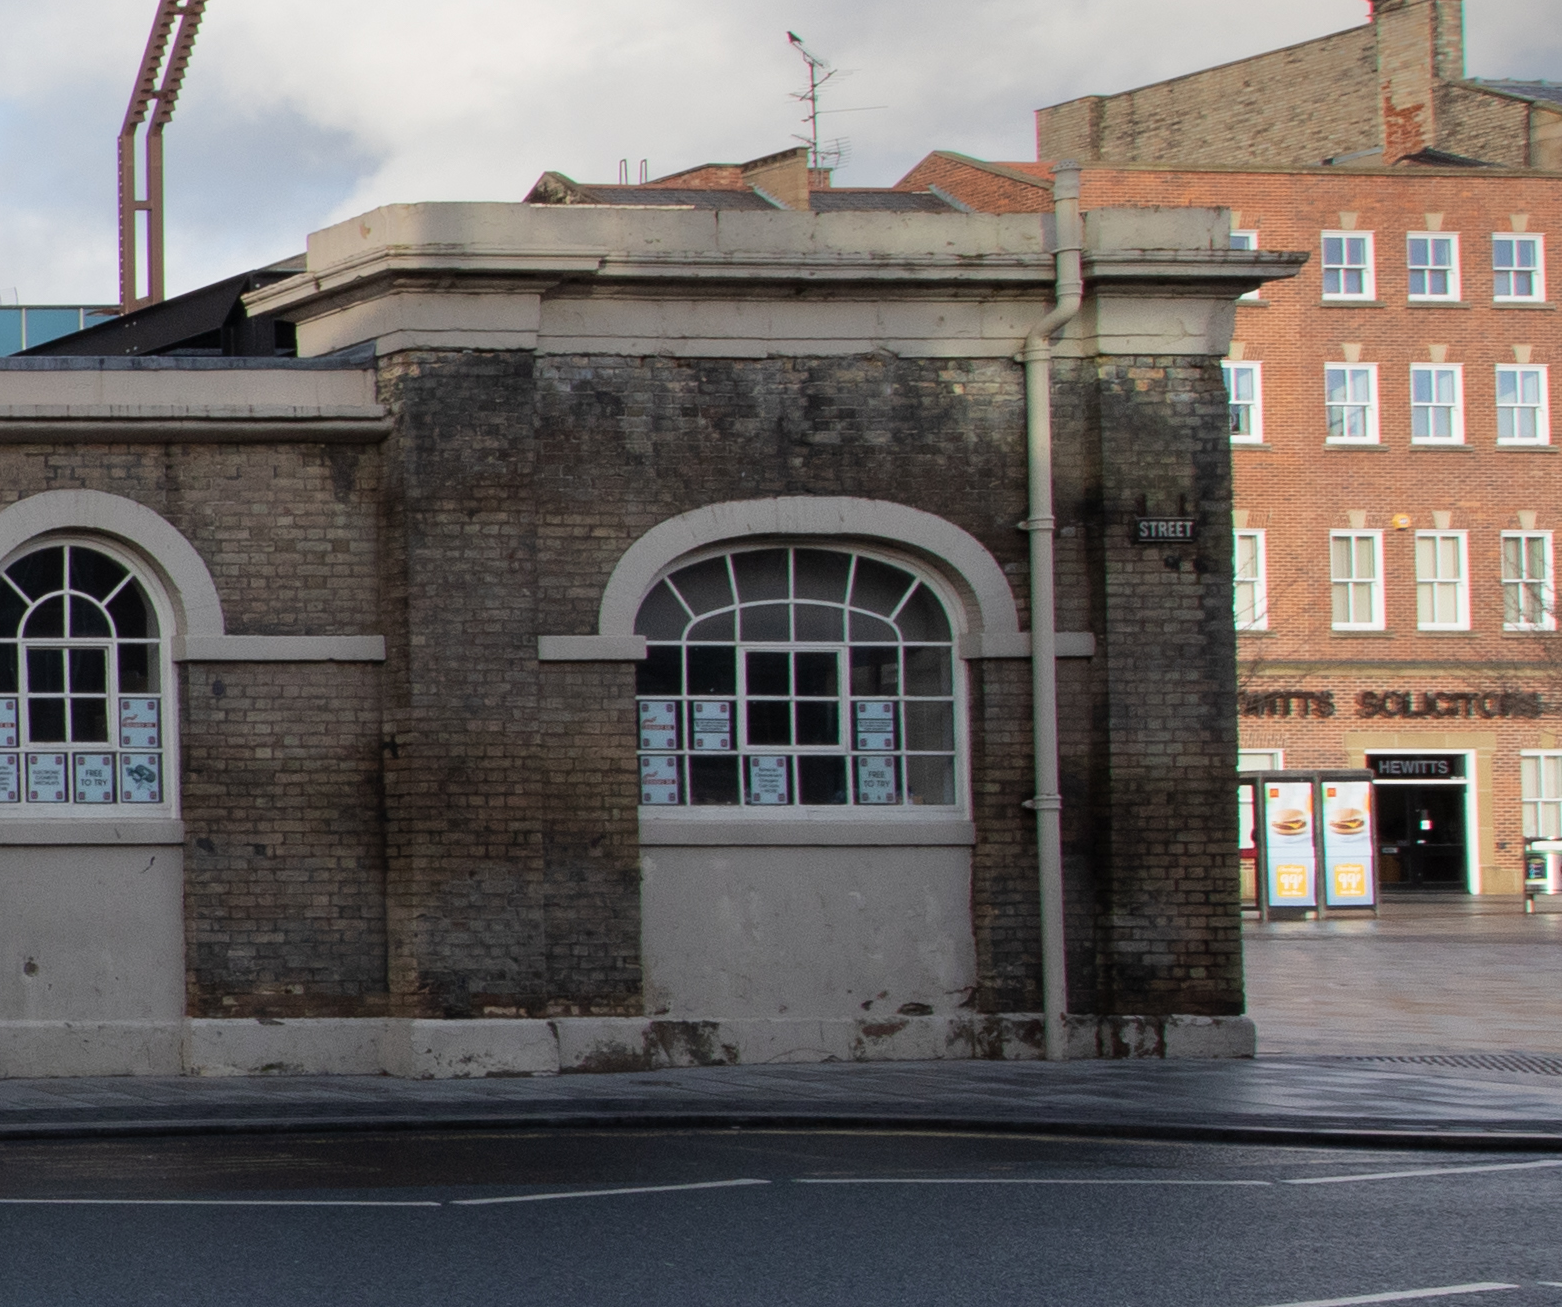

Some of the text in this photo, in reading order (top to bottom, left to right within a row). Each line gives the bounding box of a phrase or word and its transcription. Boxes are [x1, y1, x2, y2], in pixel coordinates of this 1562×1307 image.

[1139, 521, 1194, 537] STREET
[1379, 760, 1449, 774] HEWITTS
[85, 769, 102, 777] FREE
[868, 770, 885, 778] FREE
